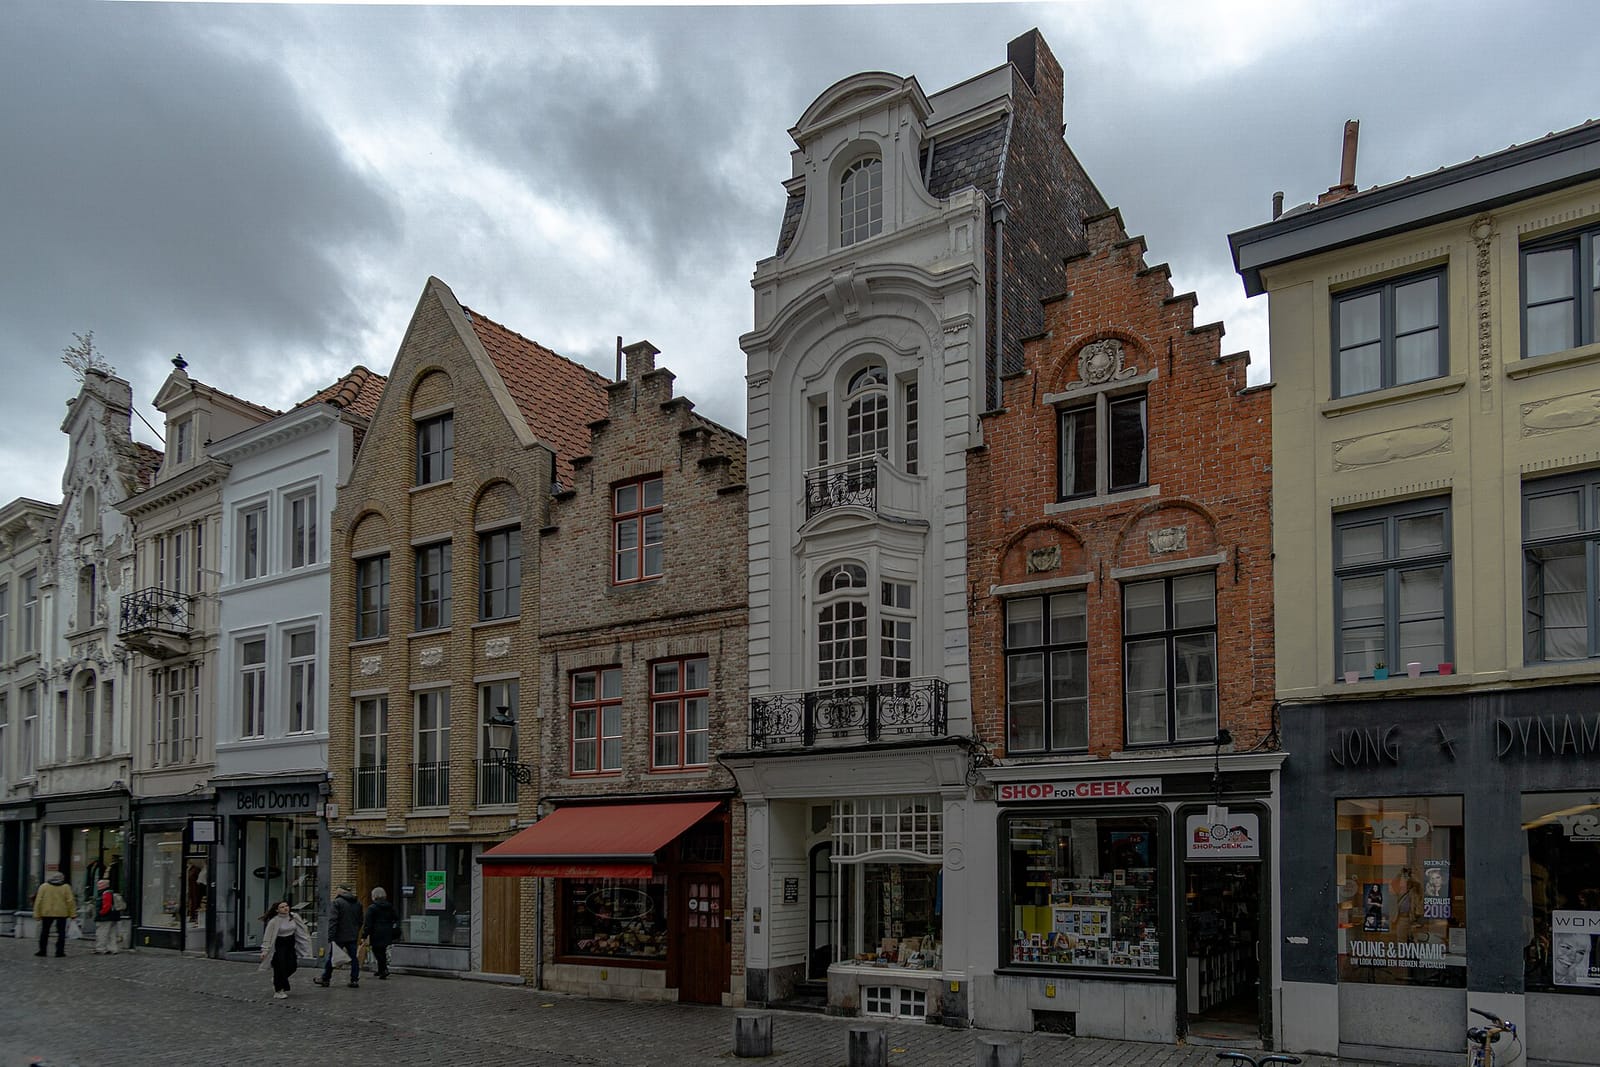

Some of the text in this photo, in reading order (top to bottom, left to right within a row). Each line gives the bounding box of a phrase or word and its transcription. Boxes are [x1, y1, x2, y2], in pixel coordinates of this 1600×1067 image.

[1330, 724, 1399, 766] JONG
[237, 790, 310, 809] Bella Donna
[1424, 897, 1451, 905] SPECIALIST
[1424, 905, 1451, 919] 2019
[1350, 940, 1446, 960] YOUNG & DYNAMIC
[1359, 958, 1373, 966] LOOK
[1387, 959, 1398, 967] EEN
[1398, 959, 1418, 968] REDKEN
[1418, 960, 1447, 969] SPECIALIST
